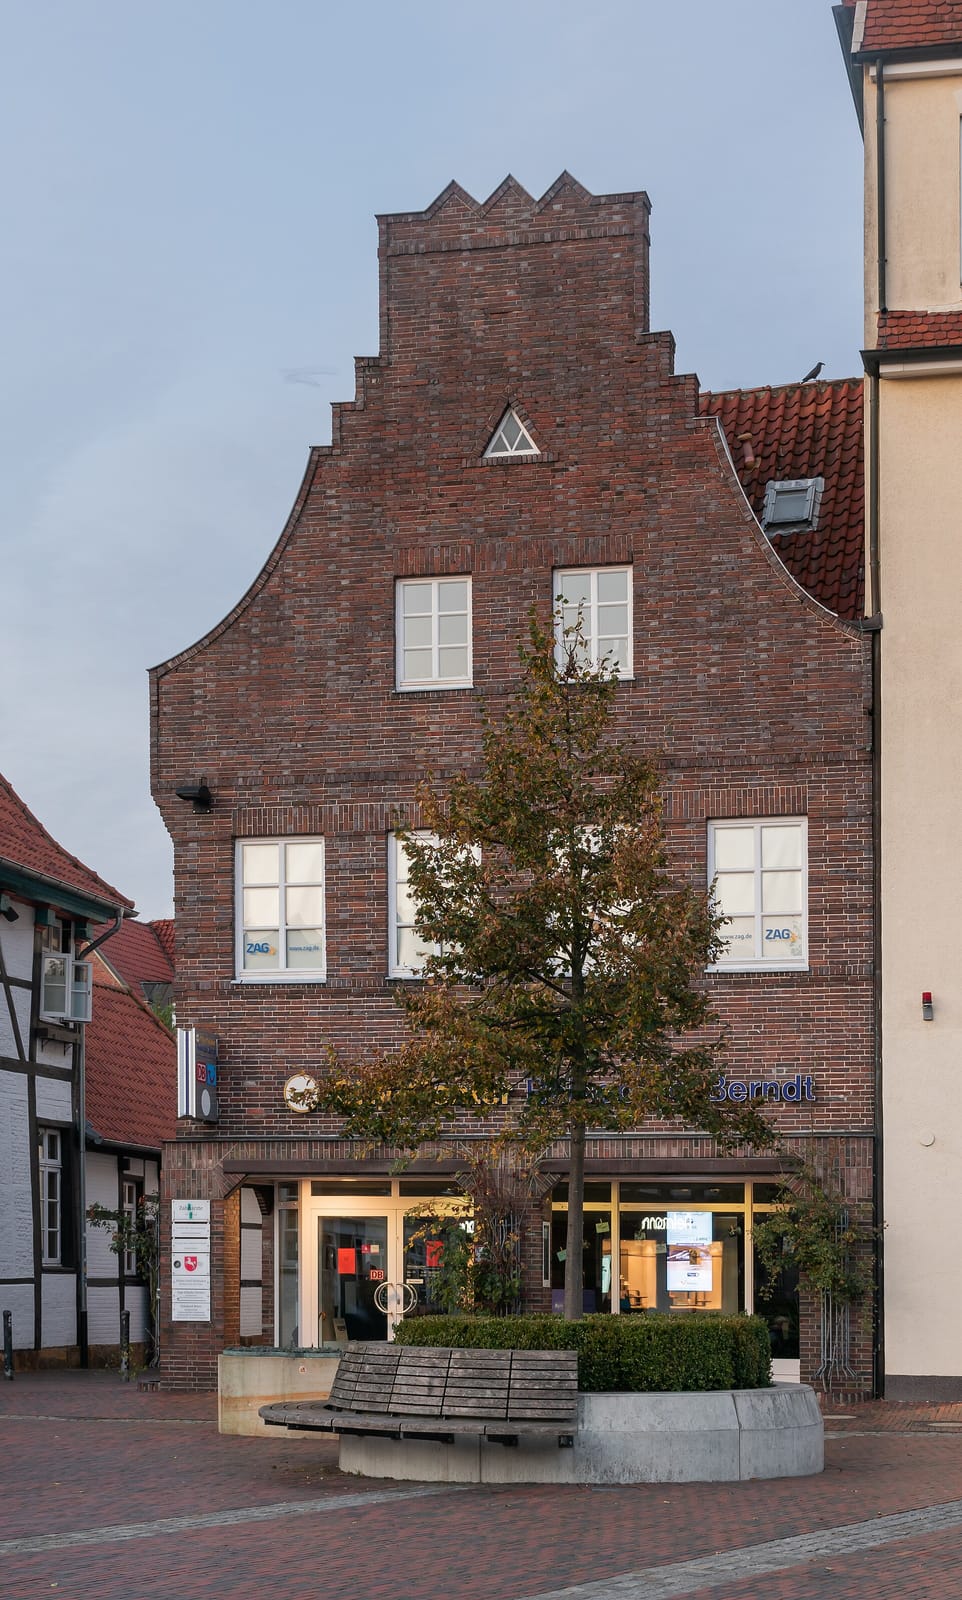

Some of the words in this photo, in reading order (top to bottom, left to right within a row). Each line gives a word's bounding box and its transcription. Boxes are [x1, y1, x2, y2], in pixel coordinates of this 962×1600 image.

[765, 928, 791, 940] ZAG
[246, 942, 270, 954] ZAG
[197, 1064, 206, 1081] DB
[709, 1074, 816, 1101] Berndt
[371, 1270, 383, 1280] DB
